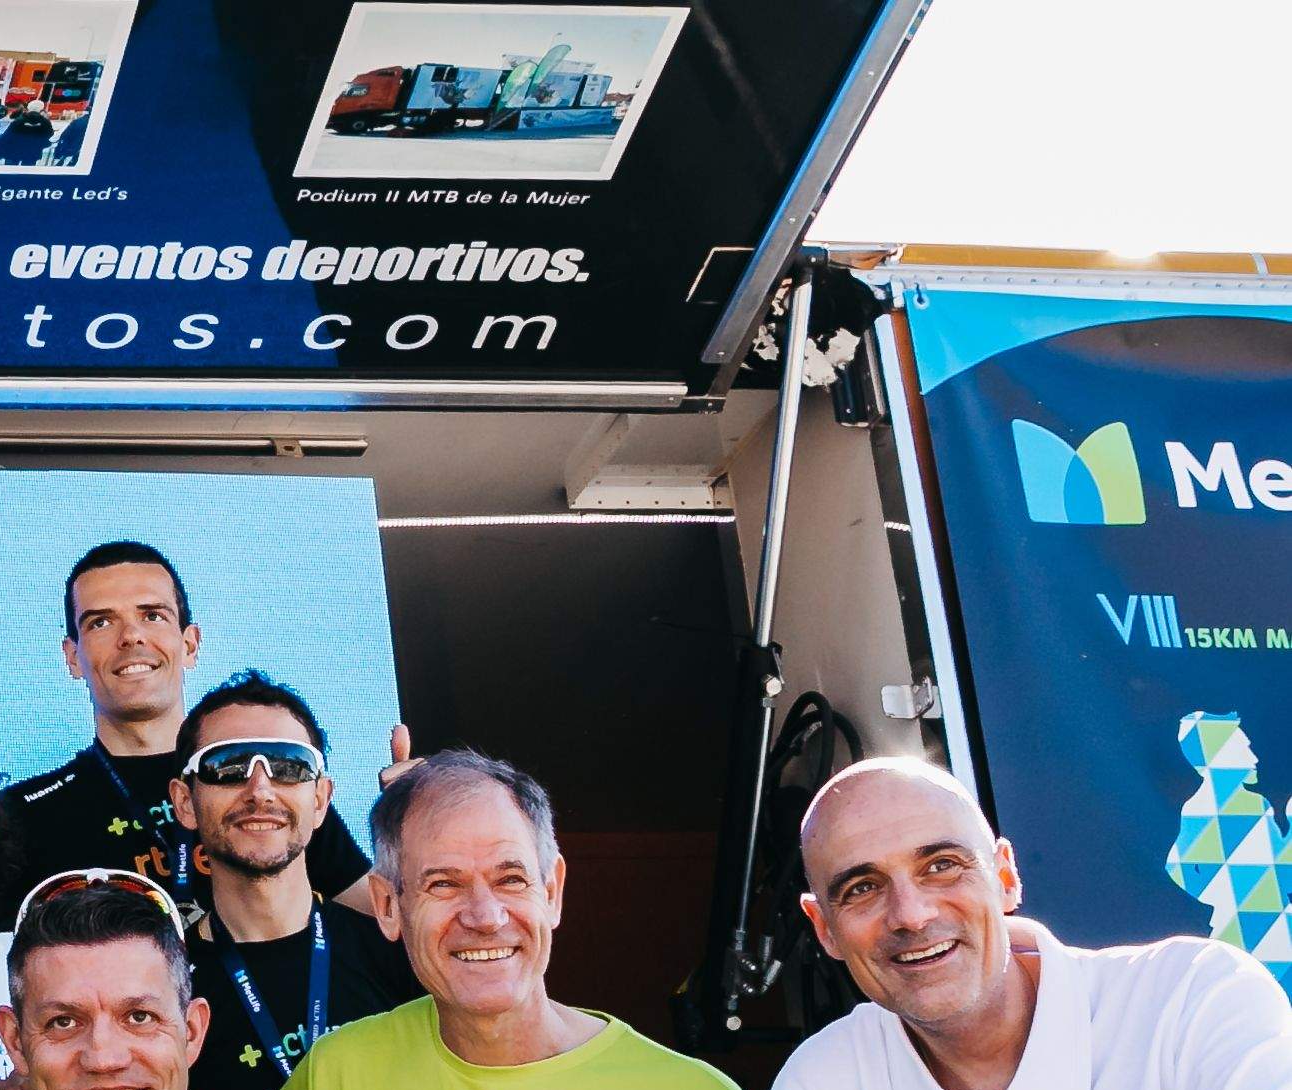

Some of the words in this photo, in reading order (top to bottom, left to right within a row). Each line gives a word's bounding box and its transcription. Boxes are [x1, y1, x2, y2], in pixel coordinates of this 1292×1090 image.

[297, 189, 377, 203] Podium
[385, 190, 400, 203] II
[407, 190, 459, 204] MTB
[466, 190, 493, 204] de
[500, 190, 518, 204] la
[526, 191, 591, 207] Mujer
[9, 241, 253, 281] eventos
[261, 239, 590, 285] deportivos.
[1096, 593, 1183, 649] VIII
[1184, 627, 1258, 649] 15KM
[134, 846, 213, 878] rte
[241, 981, 261, 1013] MetLife
